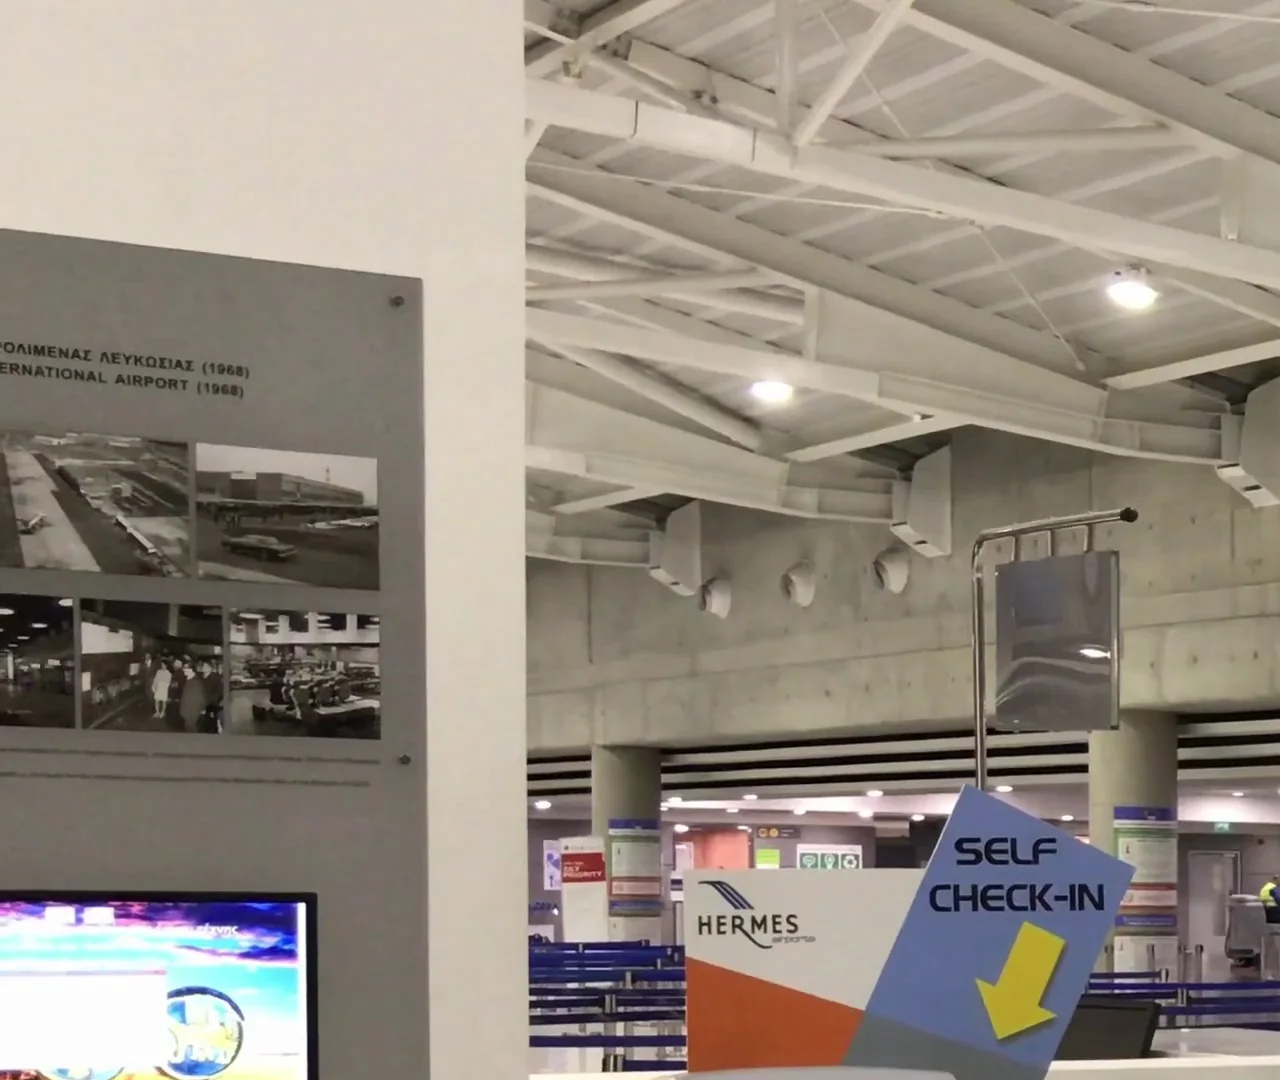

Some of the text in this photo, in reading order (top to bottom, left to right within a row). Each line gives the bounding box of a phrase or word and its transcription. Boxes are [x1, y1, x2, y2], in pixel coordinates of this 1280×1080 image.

[100, 352, 195, 372] ΛΕΥΚΩΣΙΑΣ
[201, 361, 250, 379] (1968)
[115, 374, 188, 391] AIRPORT
[196, 381, 244, 398] (1968)
[954, 837, 1058, 866] SELF
[563, 871, 602, 879] PRIORITY
[929, 883, 1105, 912] CHECK-IN
[698, 914, 799, 949] HERMES
